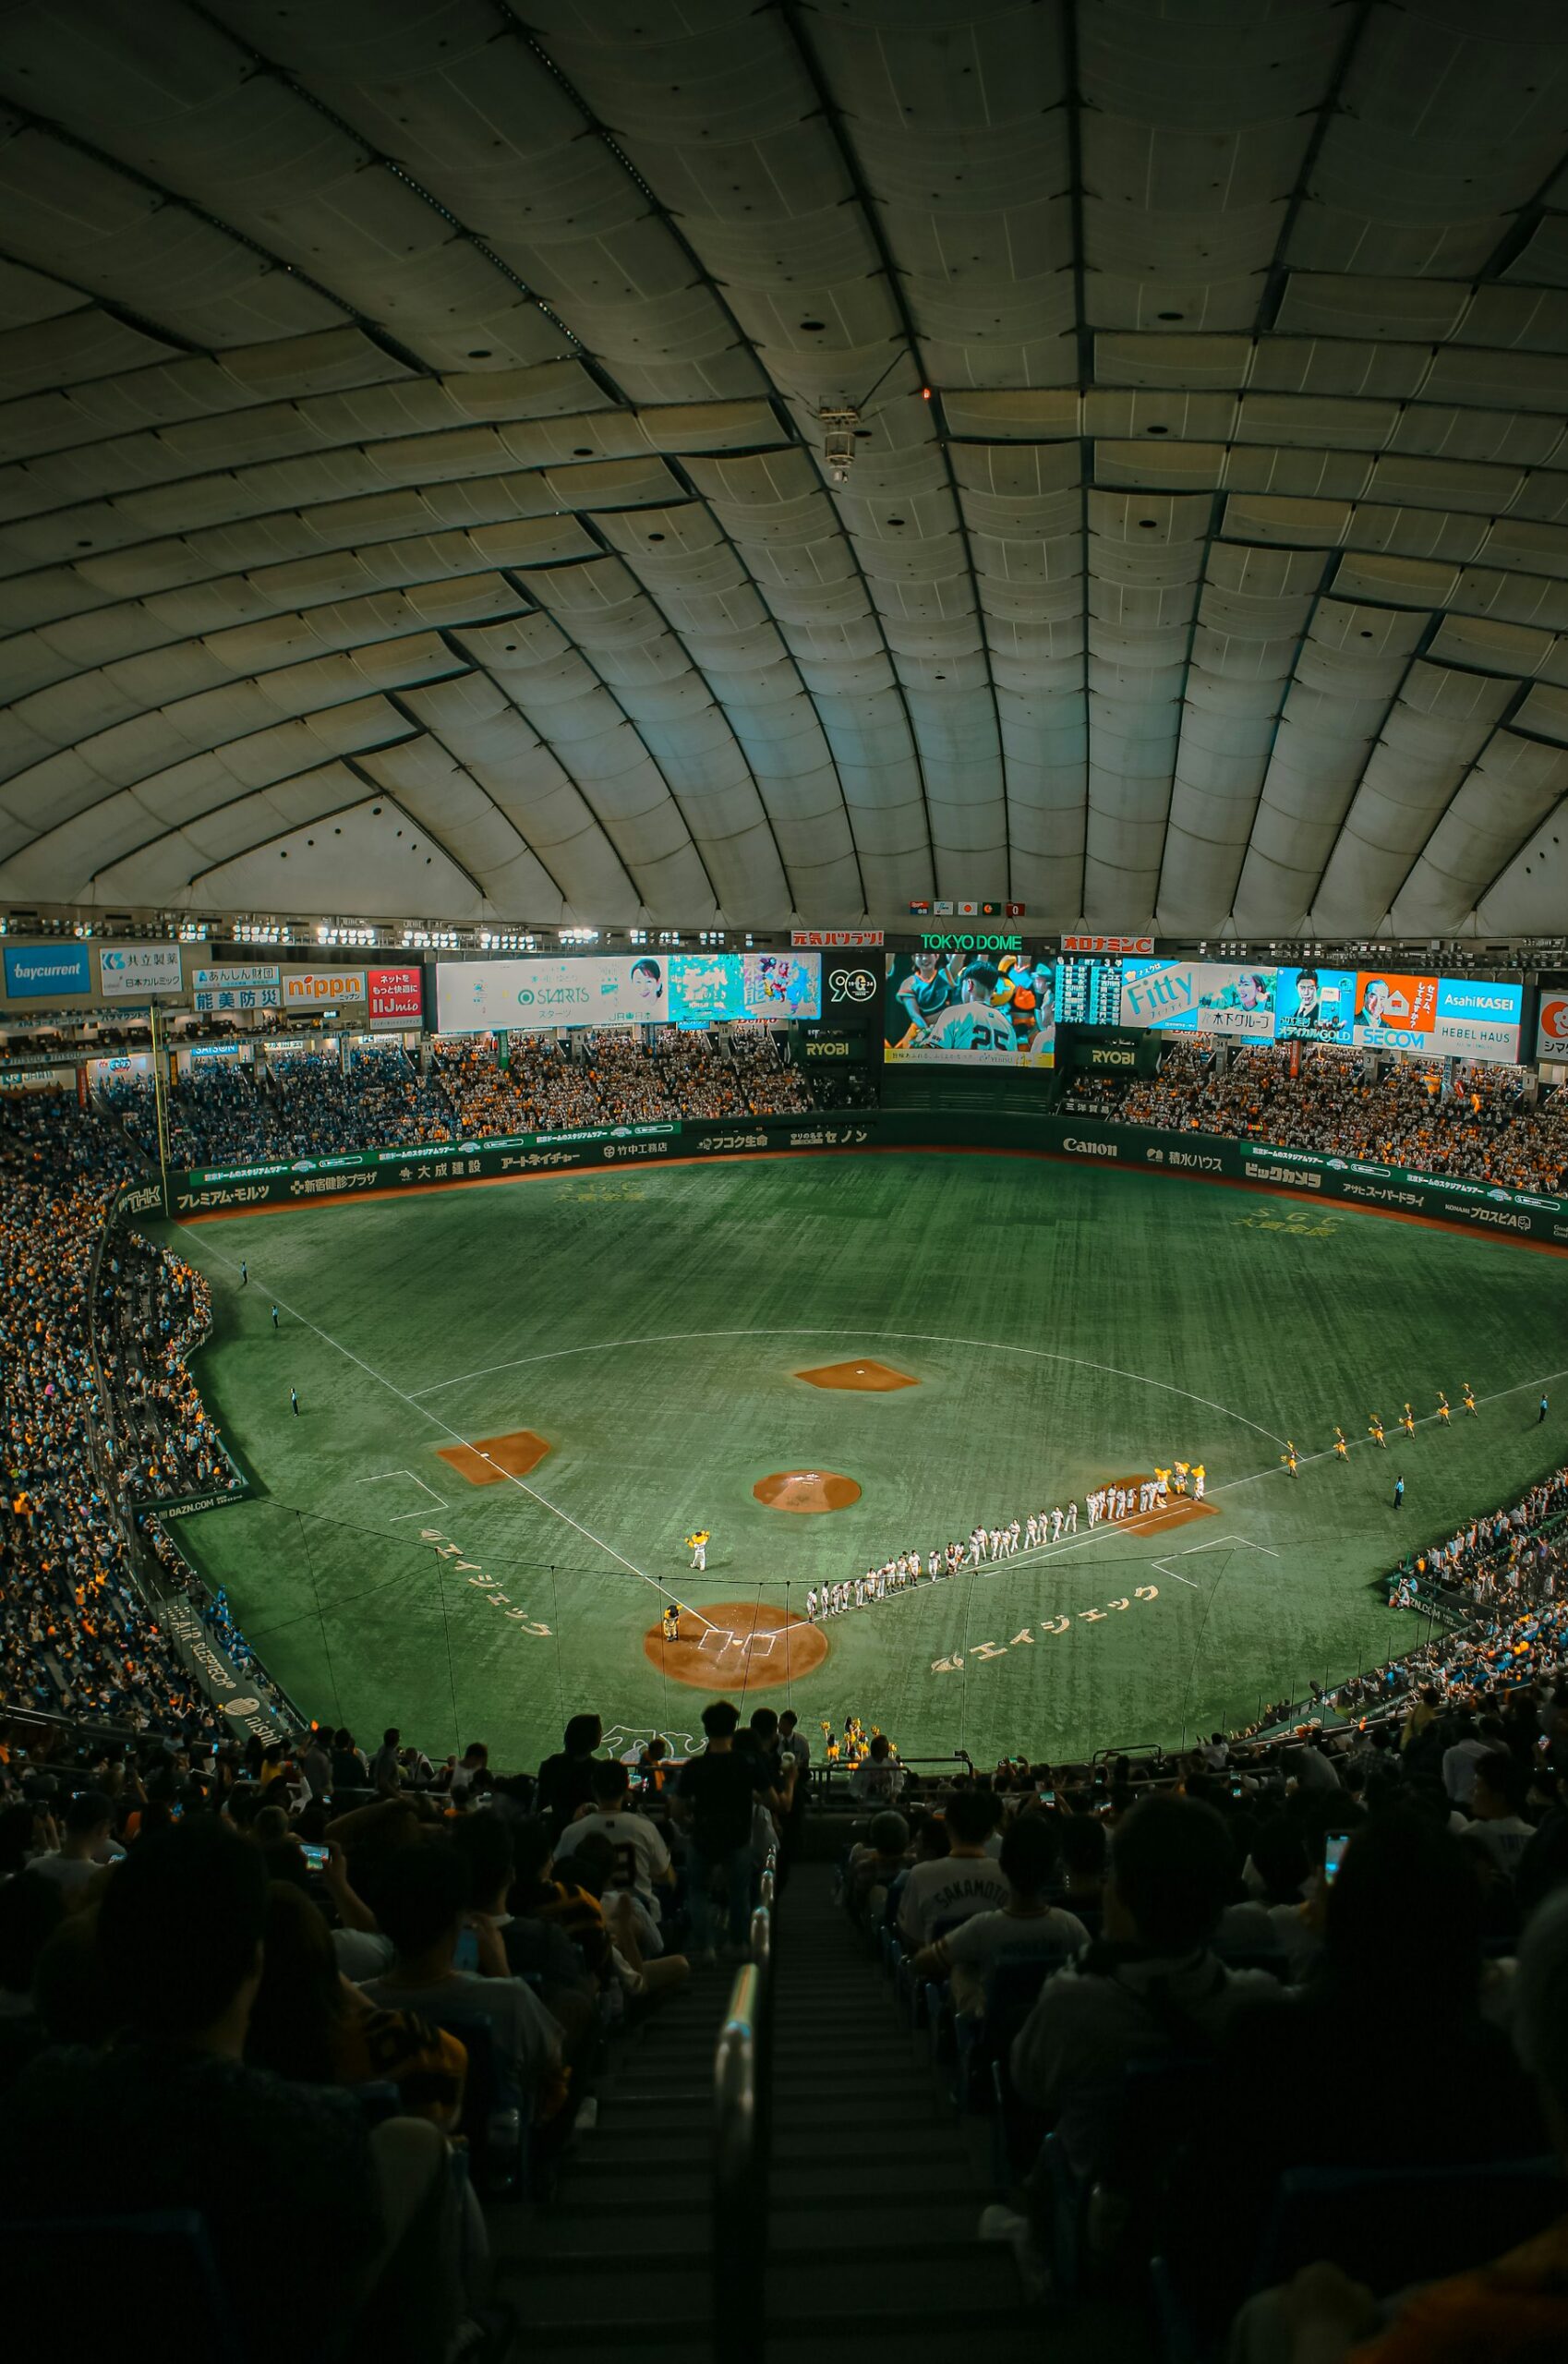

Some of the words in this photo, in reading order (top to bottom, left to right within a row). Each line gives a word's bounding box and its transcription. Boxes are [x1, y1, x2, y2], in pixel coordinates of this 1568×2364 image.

[792, 932, 884, 946] 元気ハツラツ!
[921, 934, 974, 949] TOKYO
[976, 935, 1022, 951] DOME
[1064, 936, 1152, 953] オロナミンC
[127, 952, 178, 968] 共立製薬
[14, 962, 81, 981] baycurrent
[209, 967, 273, 982] あんしん財団
[380, 974, 410, 983] ネットを
[126, 975, 180, 988] 日本カルミック
[288, 975, 361, 998] nippn
[372, 984, 418, 995] もっと快適に
[197, 989, 277, 1011] 能美防災
[1127, 971, 1192, 1015] Fitty
[538, 1009, 572, 1020] スターツ
[1212, 1012, 1270, 1029] 木下グループ
[971, 1024, 1010, 1051] 25
[1362, 1028, 1426, 1050] SECOM
[1441, 1027, 1477, 1041] HEBEL
[1479, 1030, 1510, 1043] HAUS
[806, 1043, 850, 1055] RYOBI
[1092, 1049, 1136, 1066] RYOBI
[713, 1134, 768, 1150] フコク生命
[825, 1129, 868, 1144] セノン
[618, 1141, 668, 1156] 竹中工務店
[1063, 1138, 1117, 1157] Canon
[417, 1159, 481, 1179] 大成建設
[501, 1152, 581, 1170] アートネイチャー
[1168, 1151, 1223, 1172] 積水ハウス
[304, 1171, 378, 1193] 新宿健診プラザ
[1245, 1162, 1321, 1188] ビックカメラ
[127, 1185, 162, 1209] THK
[176, 1185, 271, 1210] プレミアム・モルツ
[1444, 1203, 1470, 1215] KONAMI
[1470, 1207, 1517, 1228] プロスピA
[168, 1498, 214, 1518] DAZN.COM
[435, 1542, 553, 1636] エイジェック
[1409, 1596, 1441, 1620] ZN.COM
[969, 1584, 1159, 1660] エイジェック
[171, 1621, 202, 1643] AIR
[934, 1878, 1008, 1909] SAKAMOTO
